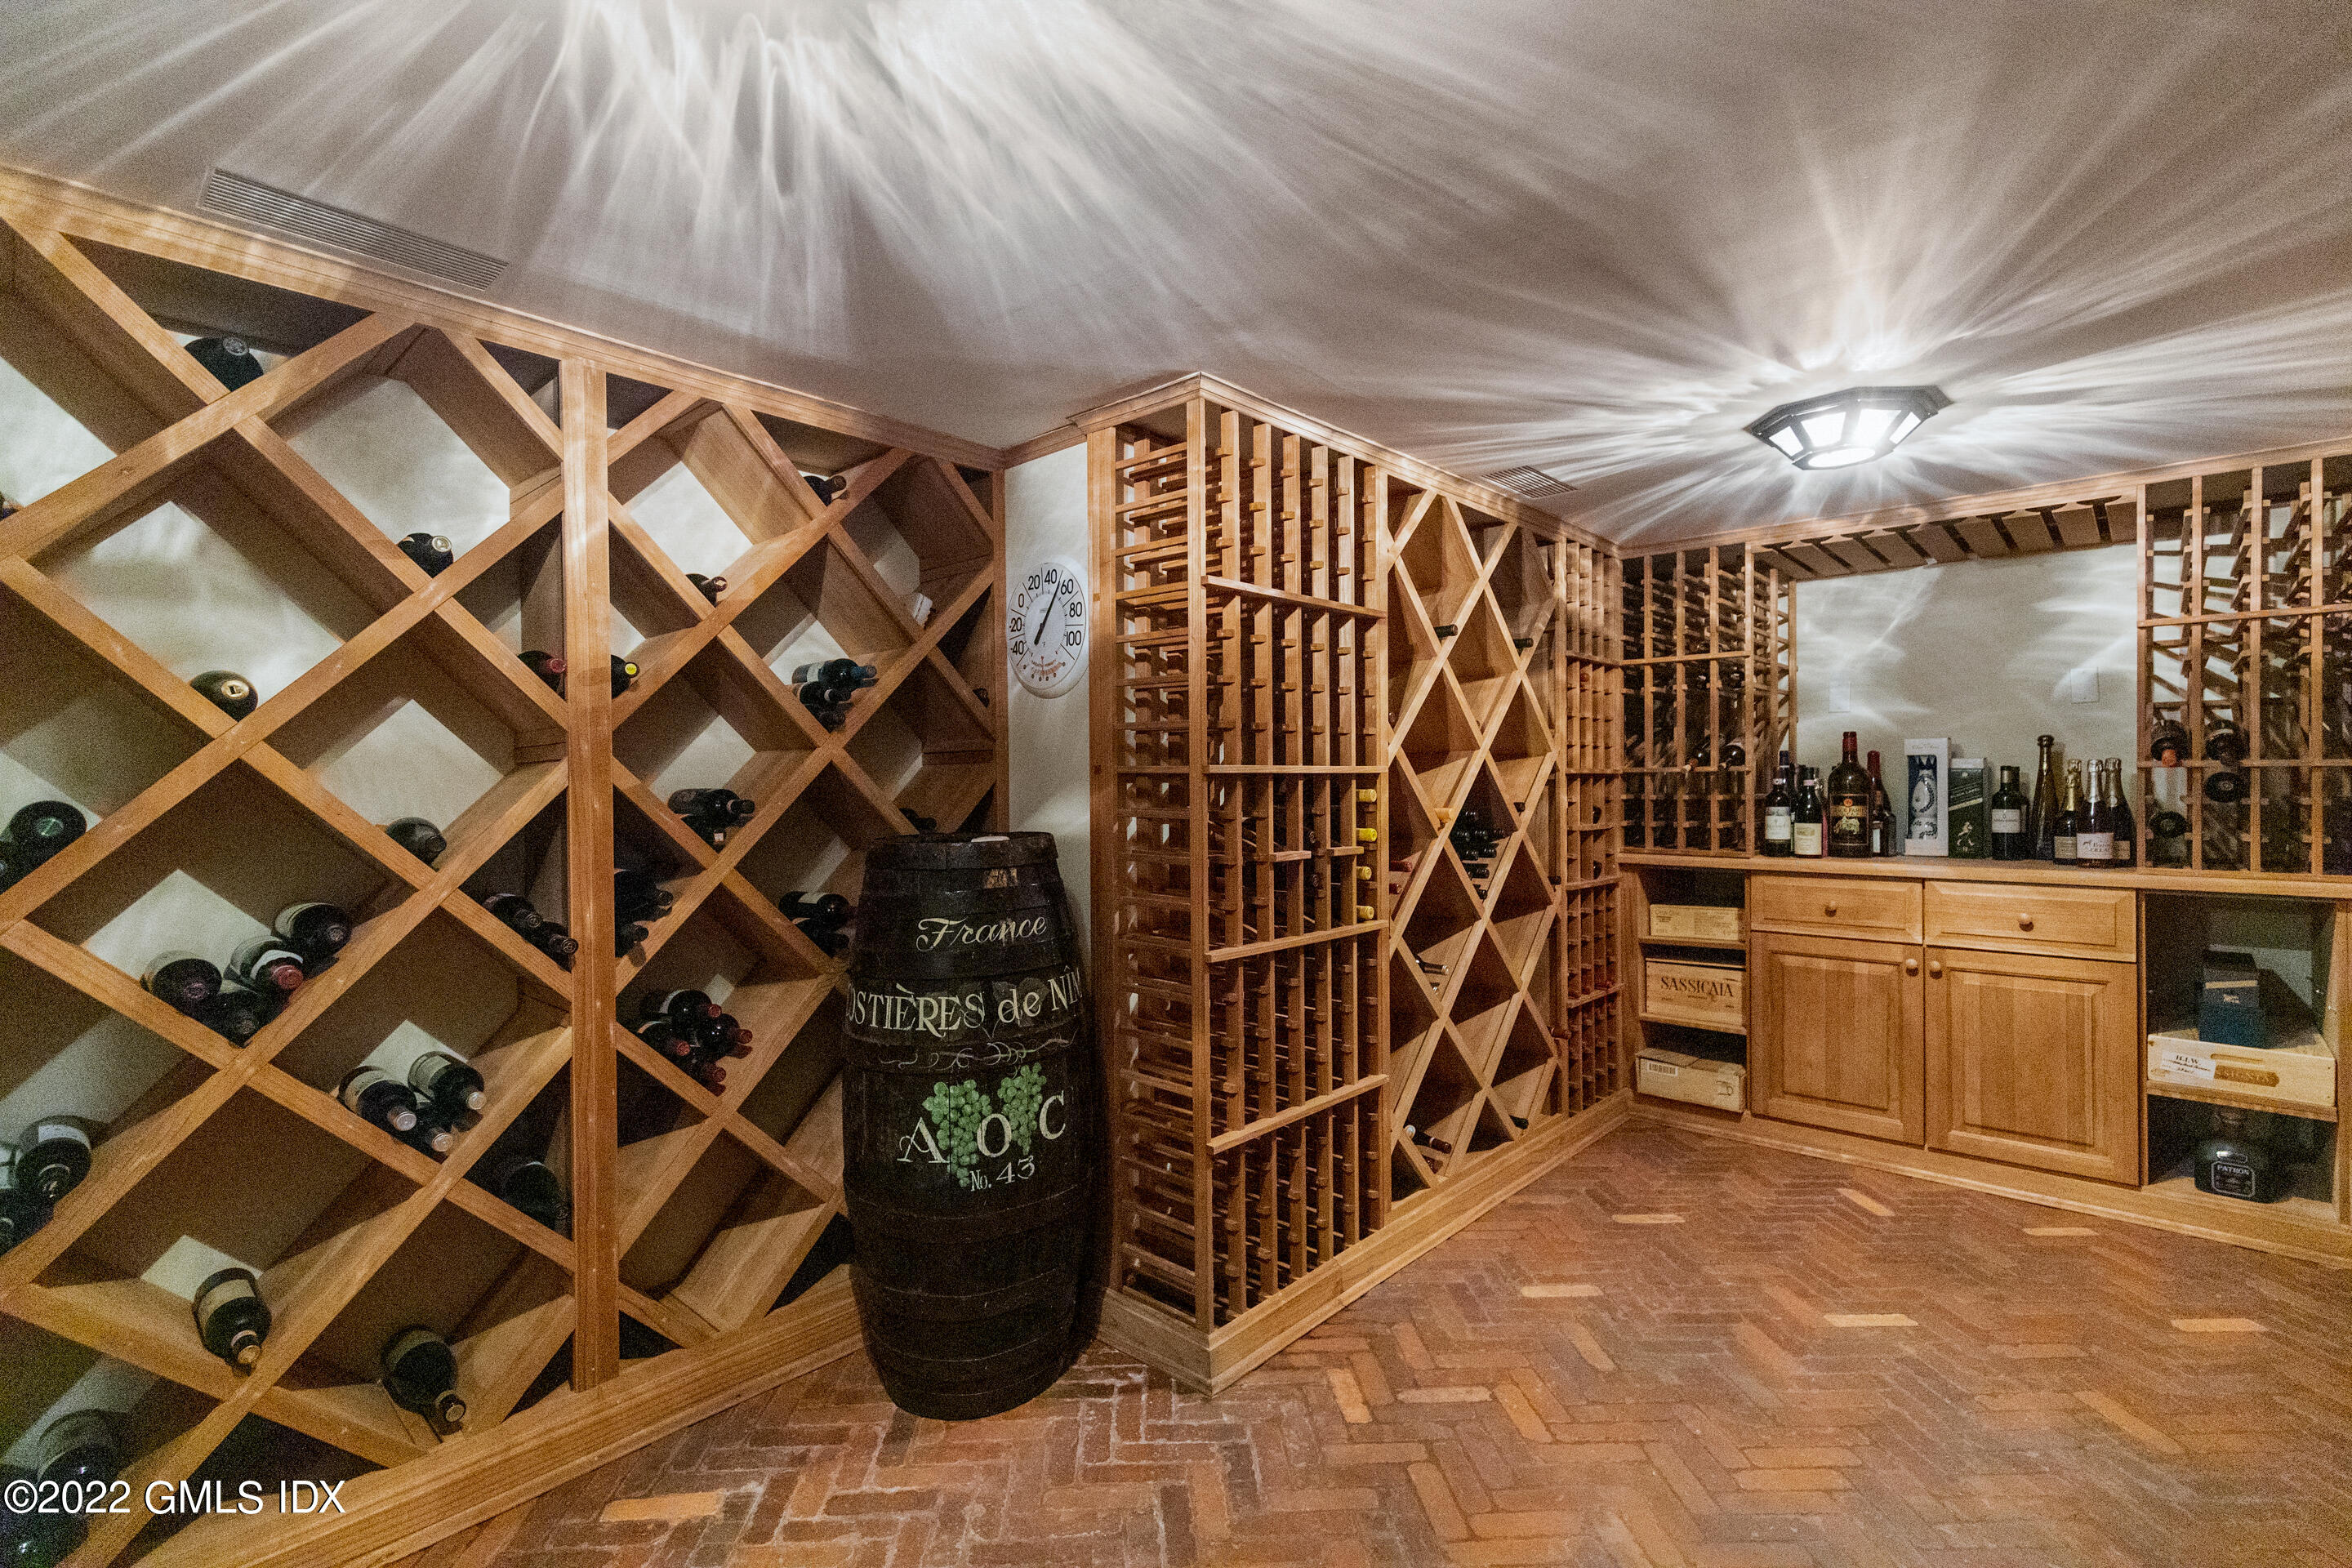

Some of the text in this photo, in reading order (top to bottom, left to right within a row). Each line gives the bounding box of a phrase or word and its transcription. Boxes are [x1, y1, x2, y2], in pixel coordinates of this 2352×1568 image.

[1028, 574, 1040, 590] 20
[1044, 568, 1058, 585] 40
[1060, 578, 1074, 595] 60
[1018, 593, 1025, 608] 0
[1069, 602, 1083, 617] 80
[1066, 630, 1082, 647] 100
[915, 916, 1047, 952] France
[1661, 976, 1734, 996] SASSICAIA
[997, 989, 1042, 1023] de
[971, 1155, 1036, 1192] No. 43
